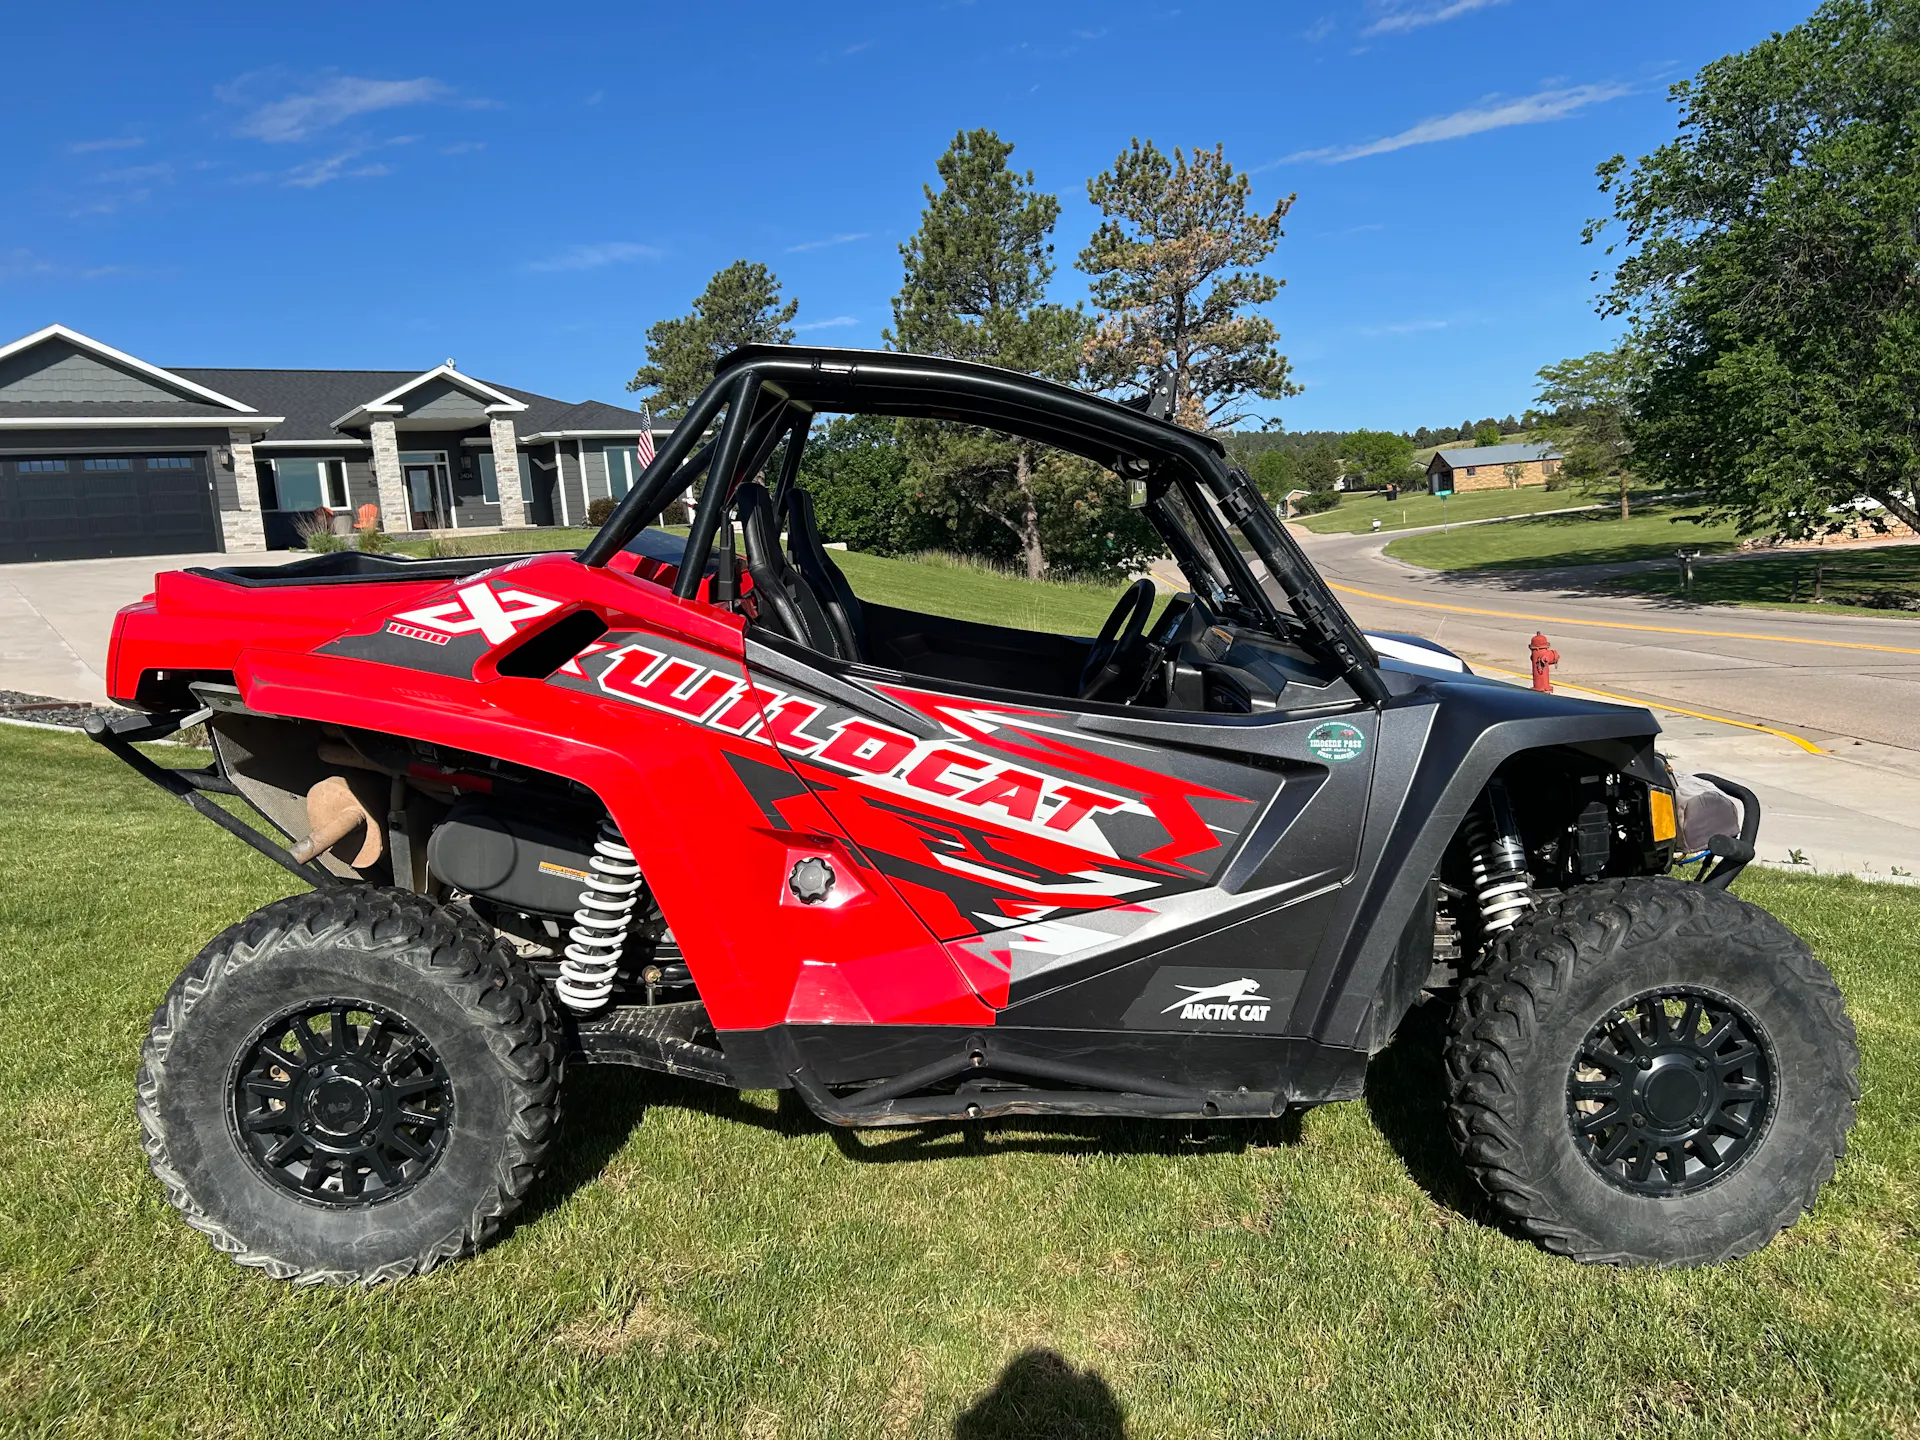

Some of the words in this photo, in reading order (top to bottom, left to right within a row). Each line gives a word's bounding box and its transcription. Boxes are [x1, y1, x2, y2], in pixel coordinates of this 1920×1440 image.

[386, 622, 452, 646] 1000
[597, 644, 1130, 832] WILDCAT
[1344, 740, 1362, 748] PASS
[1180, 1003, 1238, 1020] ARCTIC
[1239, 1005, 1271, 1021] CAT
